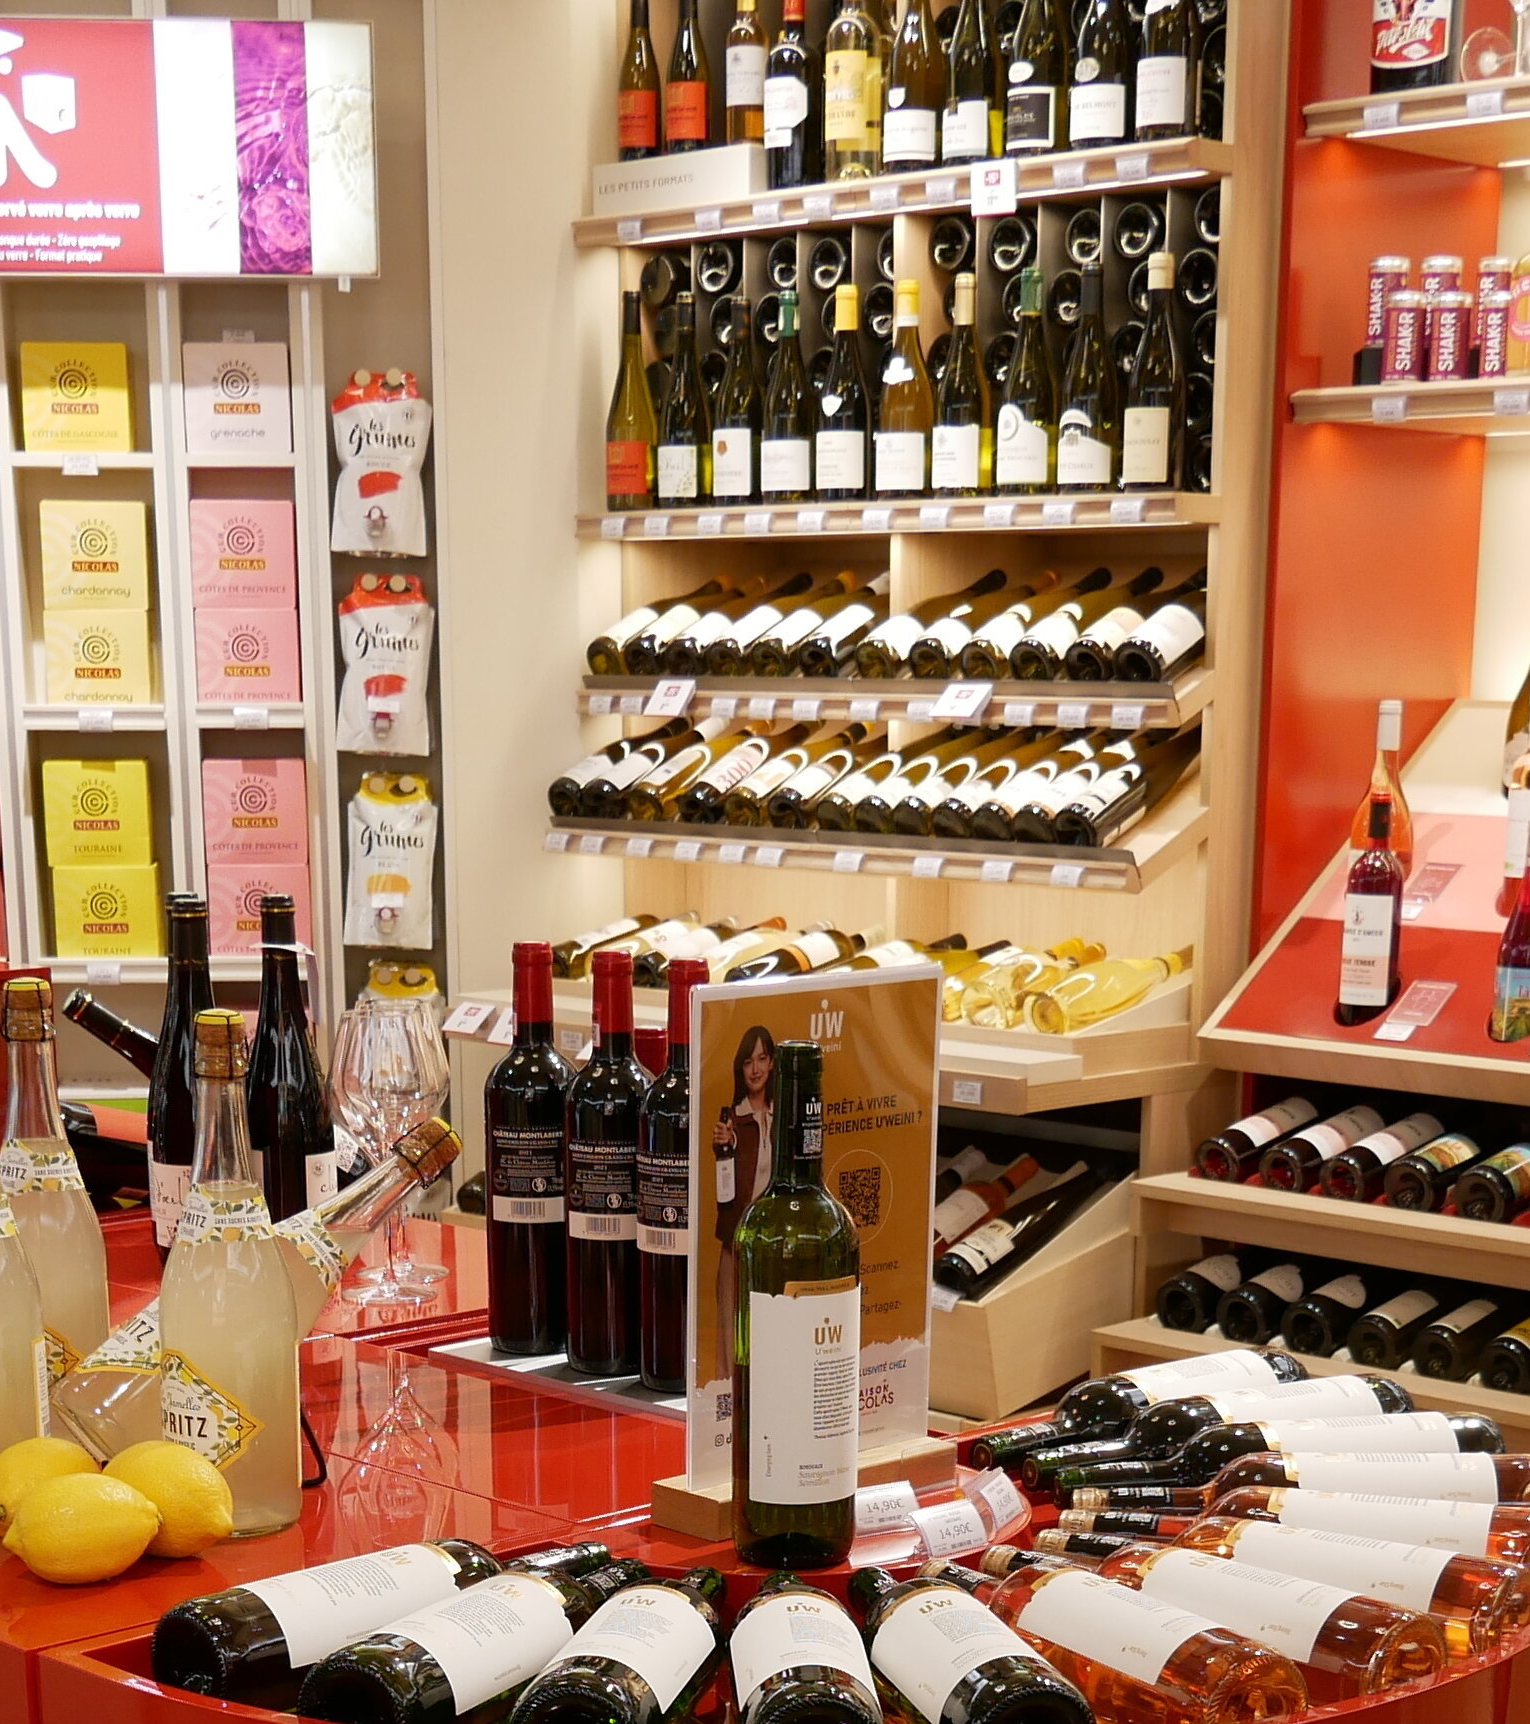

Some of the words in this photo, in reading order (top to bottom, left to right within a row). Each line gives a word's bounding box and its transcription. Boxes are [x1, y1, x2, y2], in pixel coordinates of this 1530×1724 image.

[598, 183, 616, 195] LES
[618, 178, 651, 192] PETITS
[652, 173, 694, 189] FORMATS
[29, 203, 64, 218] verre
[65, 201, 103, 221] après
[105, 203, 140, 219] verre
[26, 234, 51, 246] durée
[5, 251, 29, 261] verre
[53, 403, 98, 415] NICOLAS
[214, 404, 260, 414] NICOLAS
[210, 427, 266, 441] grenache
[73, 561, 119, 573] NICOLAS
[220, 559, 265, 570] NICOLAS
[61, 585, 131, 598] chardonnay
[242, 584, 287, 594] PROVENCE
[76, 668, 120, 678] NICOLAS
[225, 666, 270, 677] NICOLAS
[64, 691, 134, 703] chardonnay
[73, 820, 120, 831] NICOLAS
[232, 817, 278, 828] NICOLAS
[73, 844, 124, 854] TOURAINE
[255, 842, 299, 851] PROVENCE
[83, 923, 129, 934] NICOLAS
[827, 1099, 854, 1116] PRÊT
[857, 1096, 865, 1112] À
[868, 1095, 897, 1110] VIVRE
[822, 1116, 873, 1136] PÉRIENCE
[875, 1113, 914, 1129] U'WEINI
[124, 1317, 156, 1343] ITZ
[859, 1361, 887, 1377] LUSIVITÉ
[888, 1359, 907, 1371] CHEZ
[859, 1383, 889, 1395] AISON
[865, 1498, 905, 1513] 14,90€
[939, 1522, 974, 1540] 14,90€
